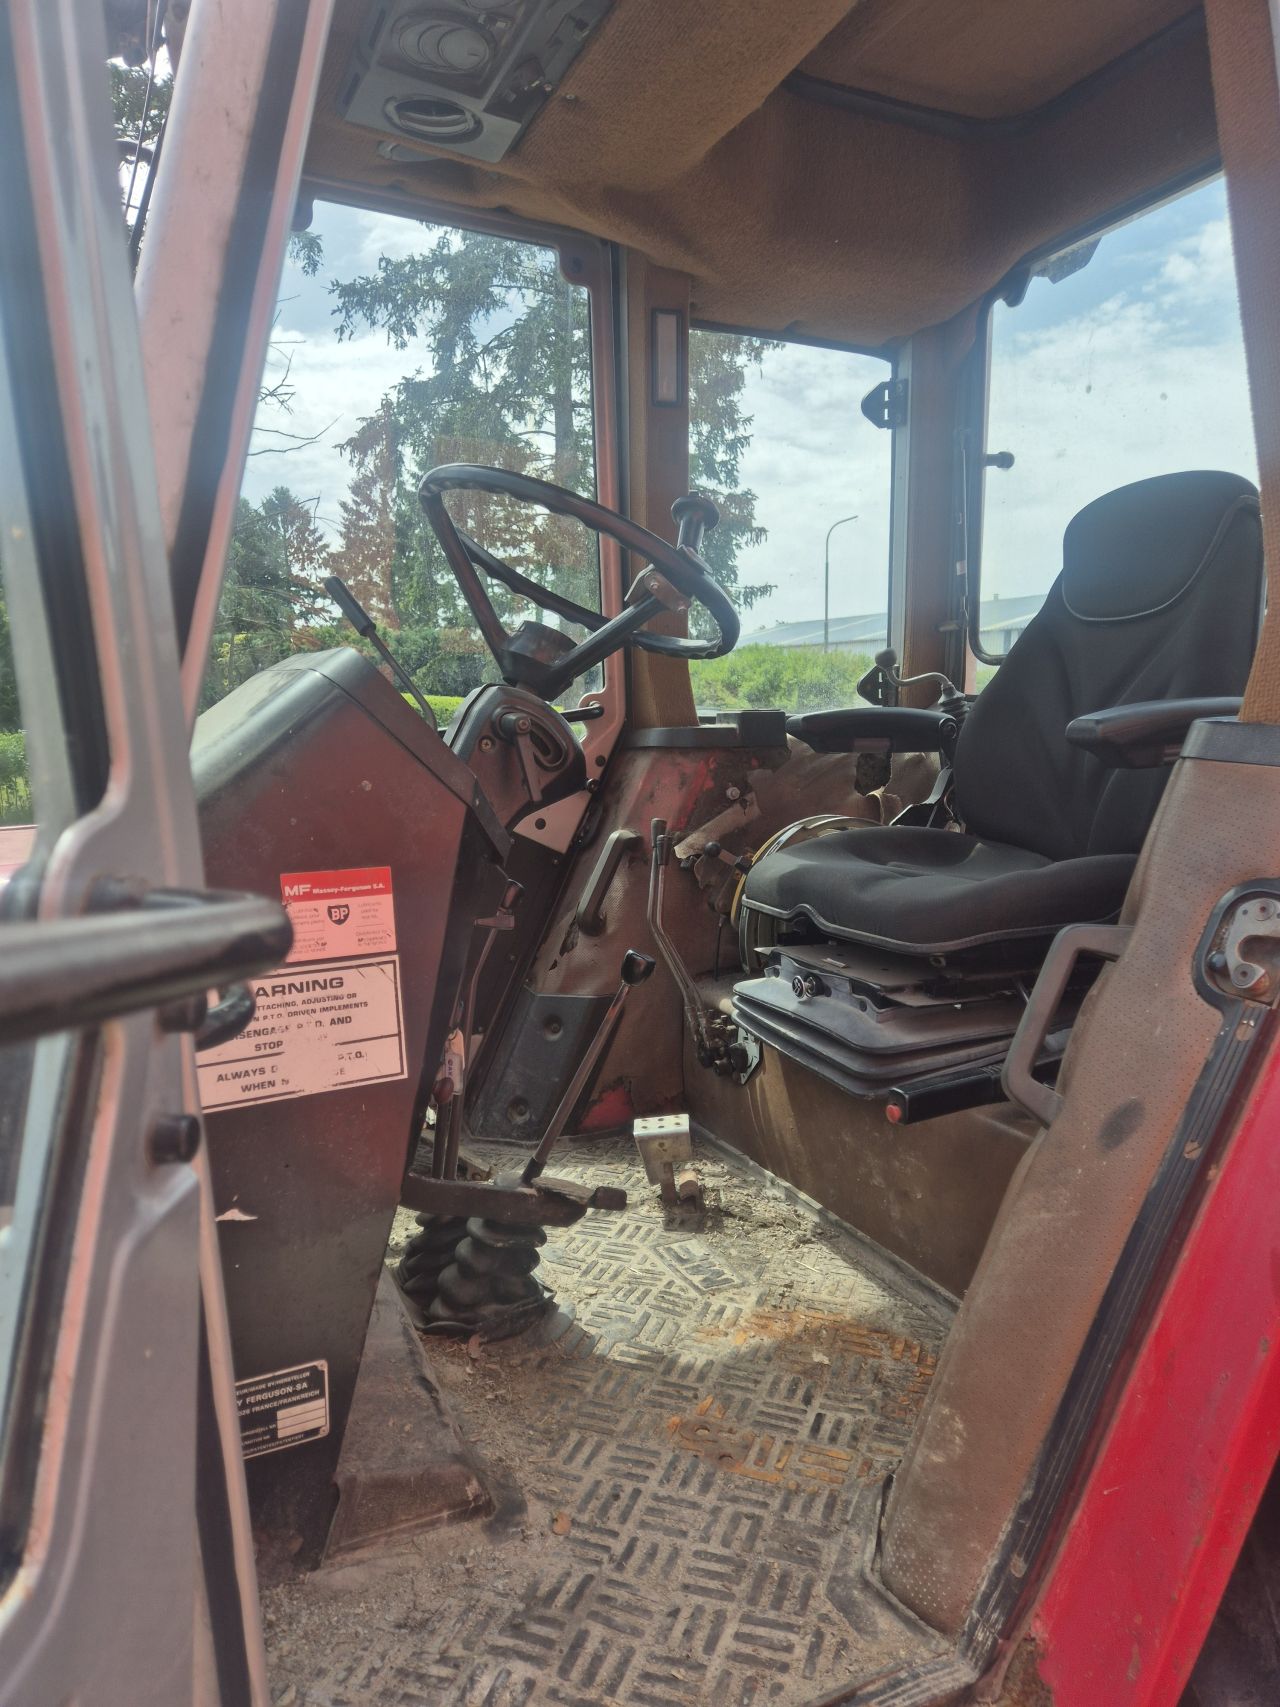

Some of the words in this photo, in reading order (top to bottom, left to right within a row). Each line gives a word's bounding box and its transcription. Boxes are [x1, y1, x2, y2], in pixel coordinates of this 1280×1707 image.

[284, 884, 311, 896] MF
[331, 907, 349, 921] BP
[255, 977, 344, 998] ARNING
[257, 1000, 299, 1012] TTACHING,
[301, 995, 344, 1006] ADJUSTING
[346, 992, 357, 1000] OR
[287, 1008, 317, 1018] DRIVEN
[319, 1001, 369, 1013] IMPLEMENTS
[329, 1015, 352, 1026] AND
[254, 1040, 284, 1051] STOP
[216, 1066, 266, 1083] ALWAYS
[240, 1079, 276, 1093] WHEN
